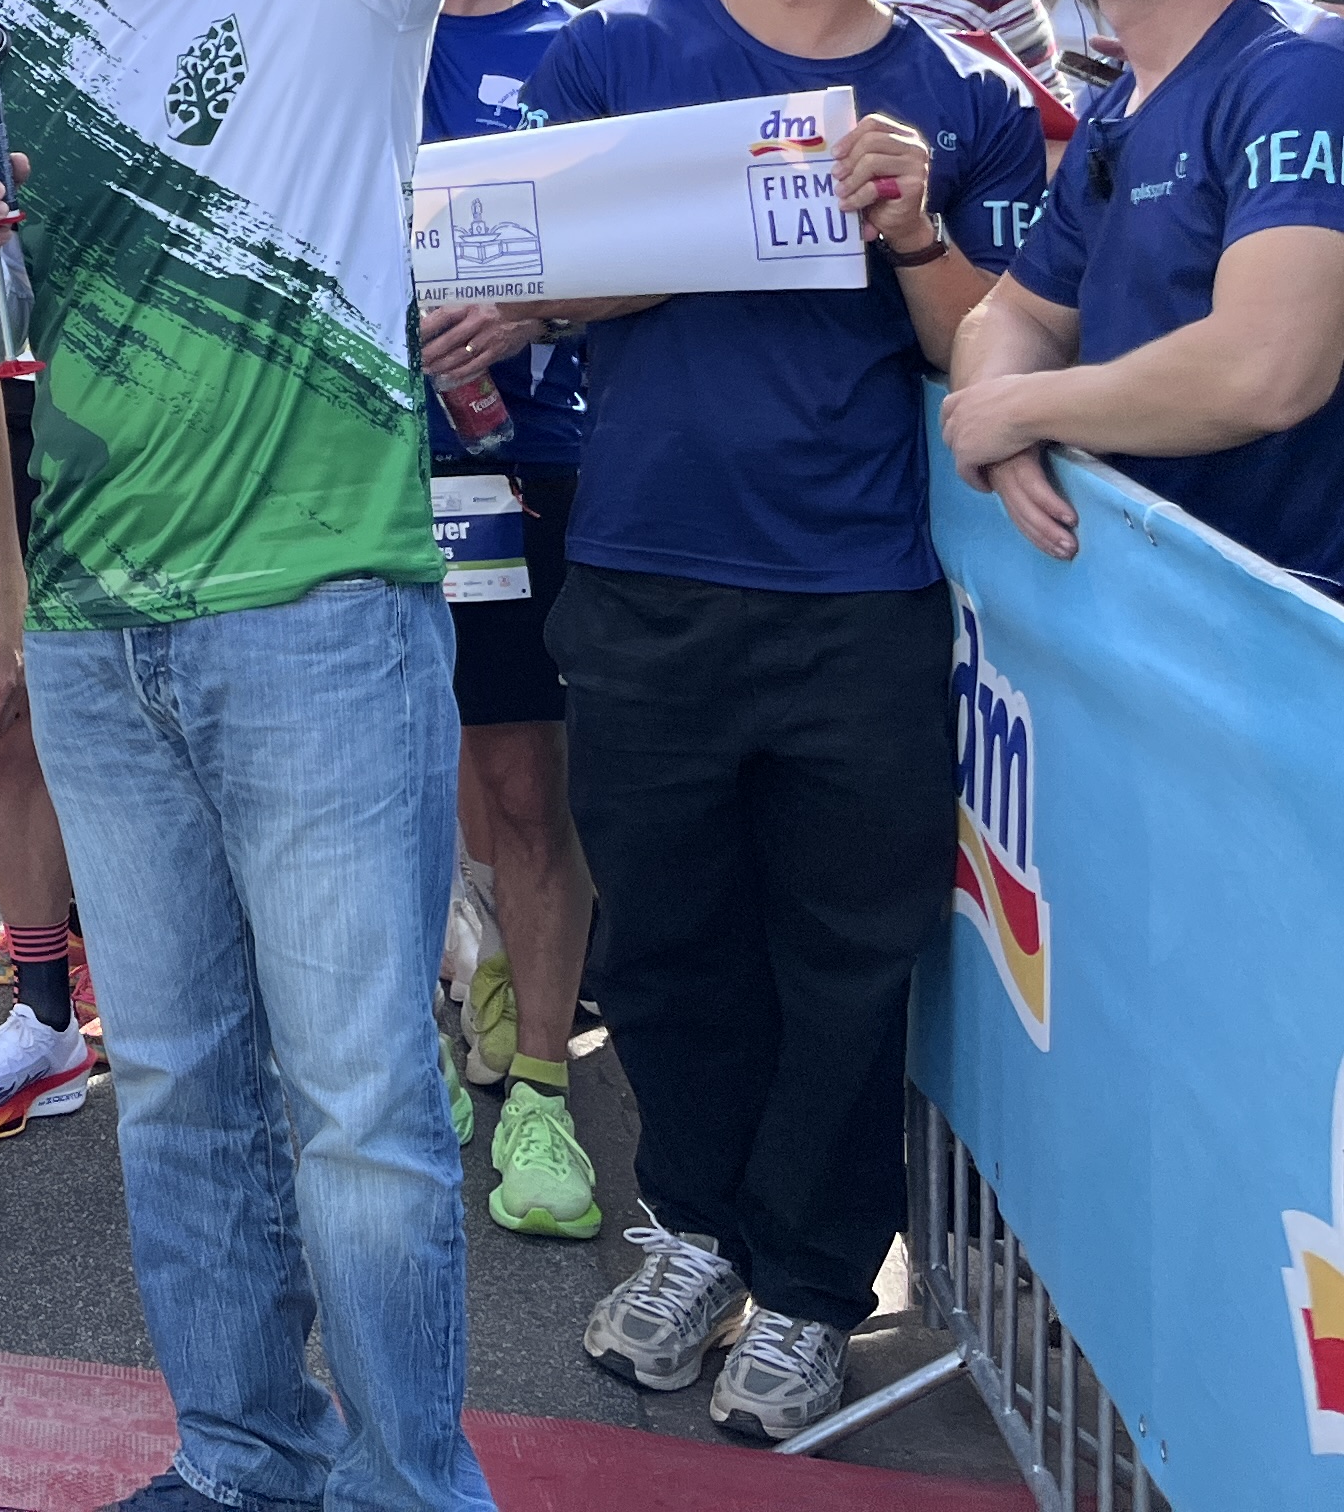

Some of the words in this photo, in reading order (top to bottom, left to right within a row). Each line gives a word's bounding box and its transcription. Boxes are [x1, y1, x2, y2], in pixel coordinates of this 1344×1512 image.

[760, 110, 817, 140] dm
[1245, 130, 1344, 190] TEA
[763, 172, 836, 202] FIRM
[768, 202, 849, 247] LAU
[417, 281, 545, 301] LAUF-HOMBURG.DE
